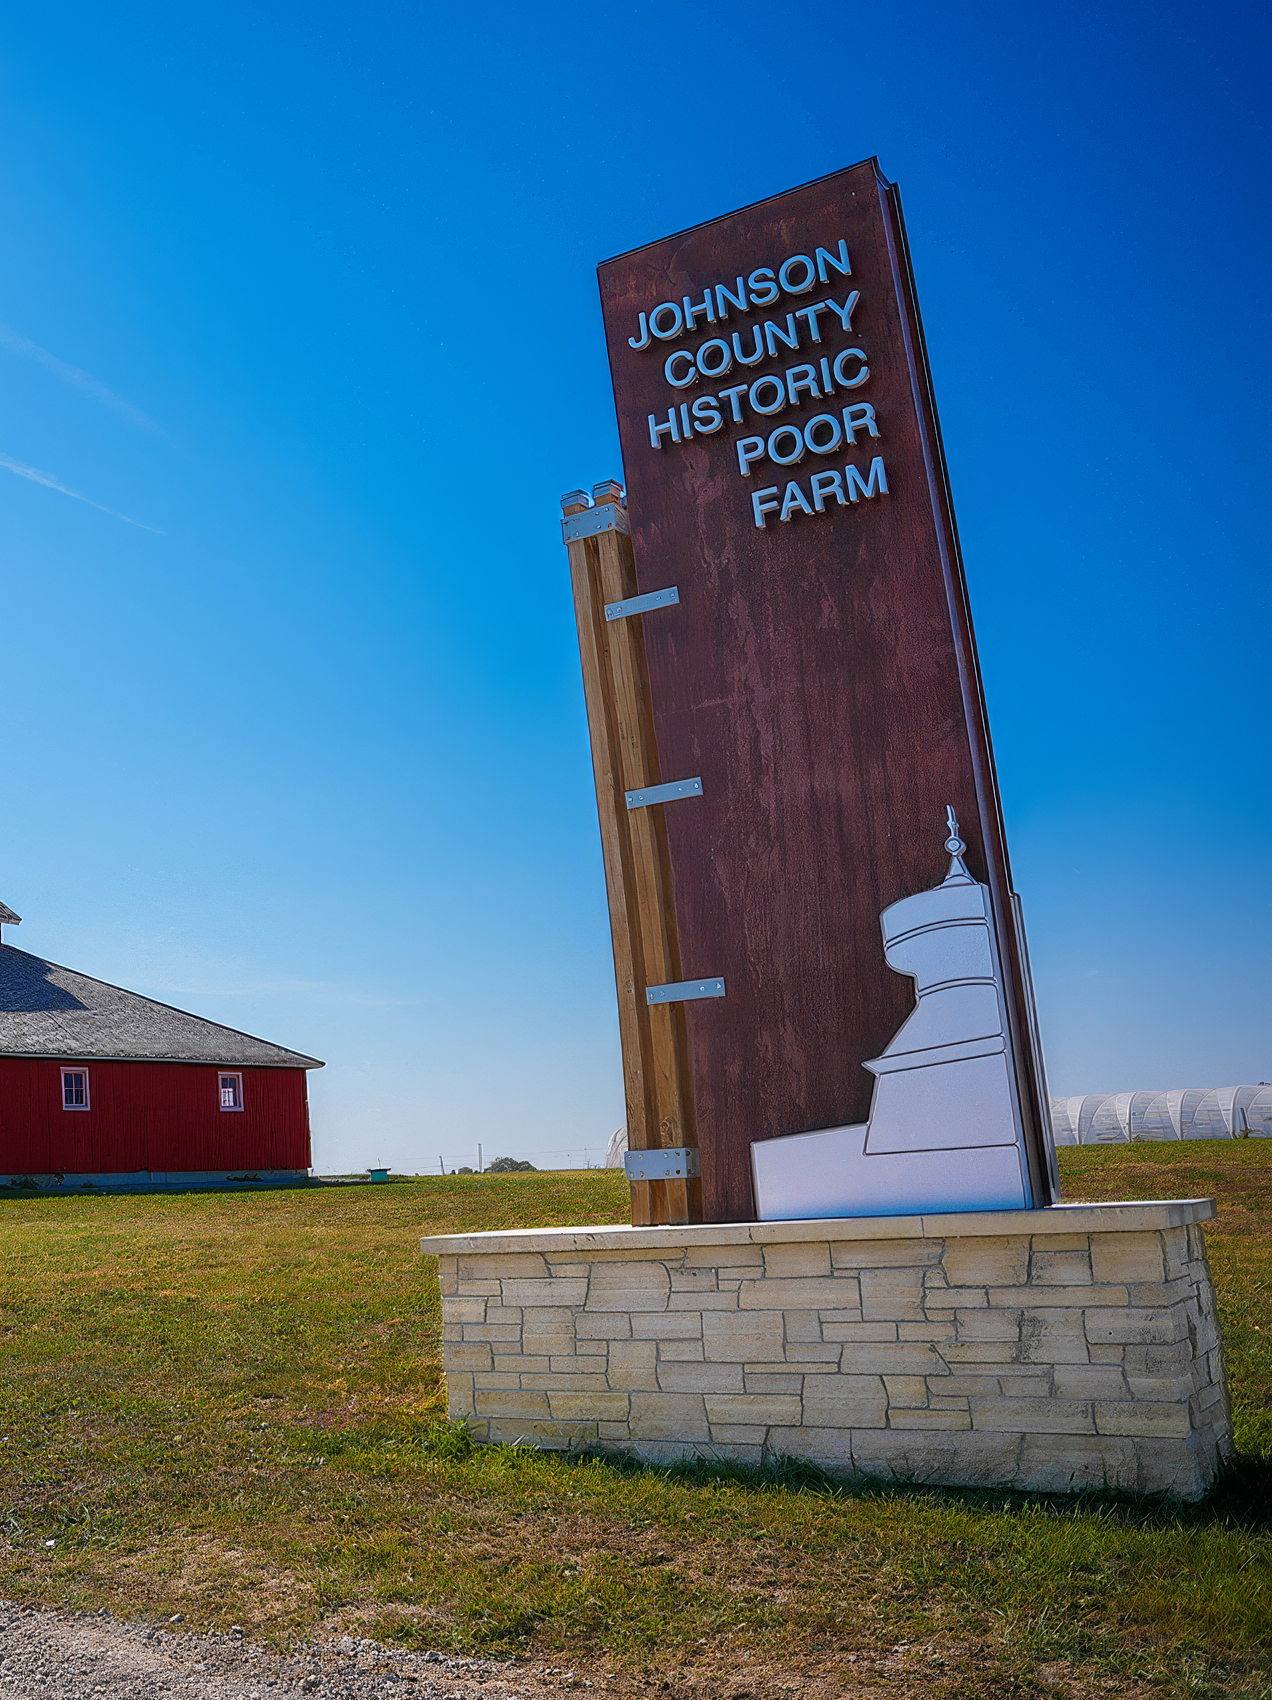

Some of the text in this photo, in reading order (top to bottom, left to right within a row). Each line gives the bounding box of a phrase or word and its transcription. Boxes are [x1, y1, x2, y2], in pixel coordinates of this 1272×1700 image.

[628, 239, 852, 351] JOHNSON
[664, 290, 860, 389] COUNTY
[648, 348, 870, 449] HISTORIC
[736, 402, 881, 477] POOR
[751, 456, 889, 528] FARM
